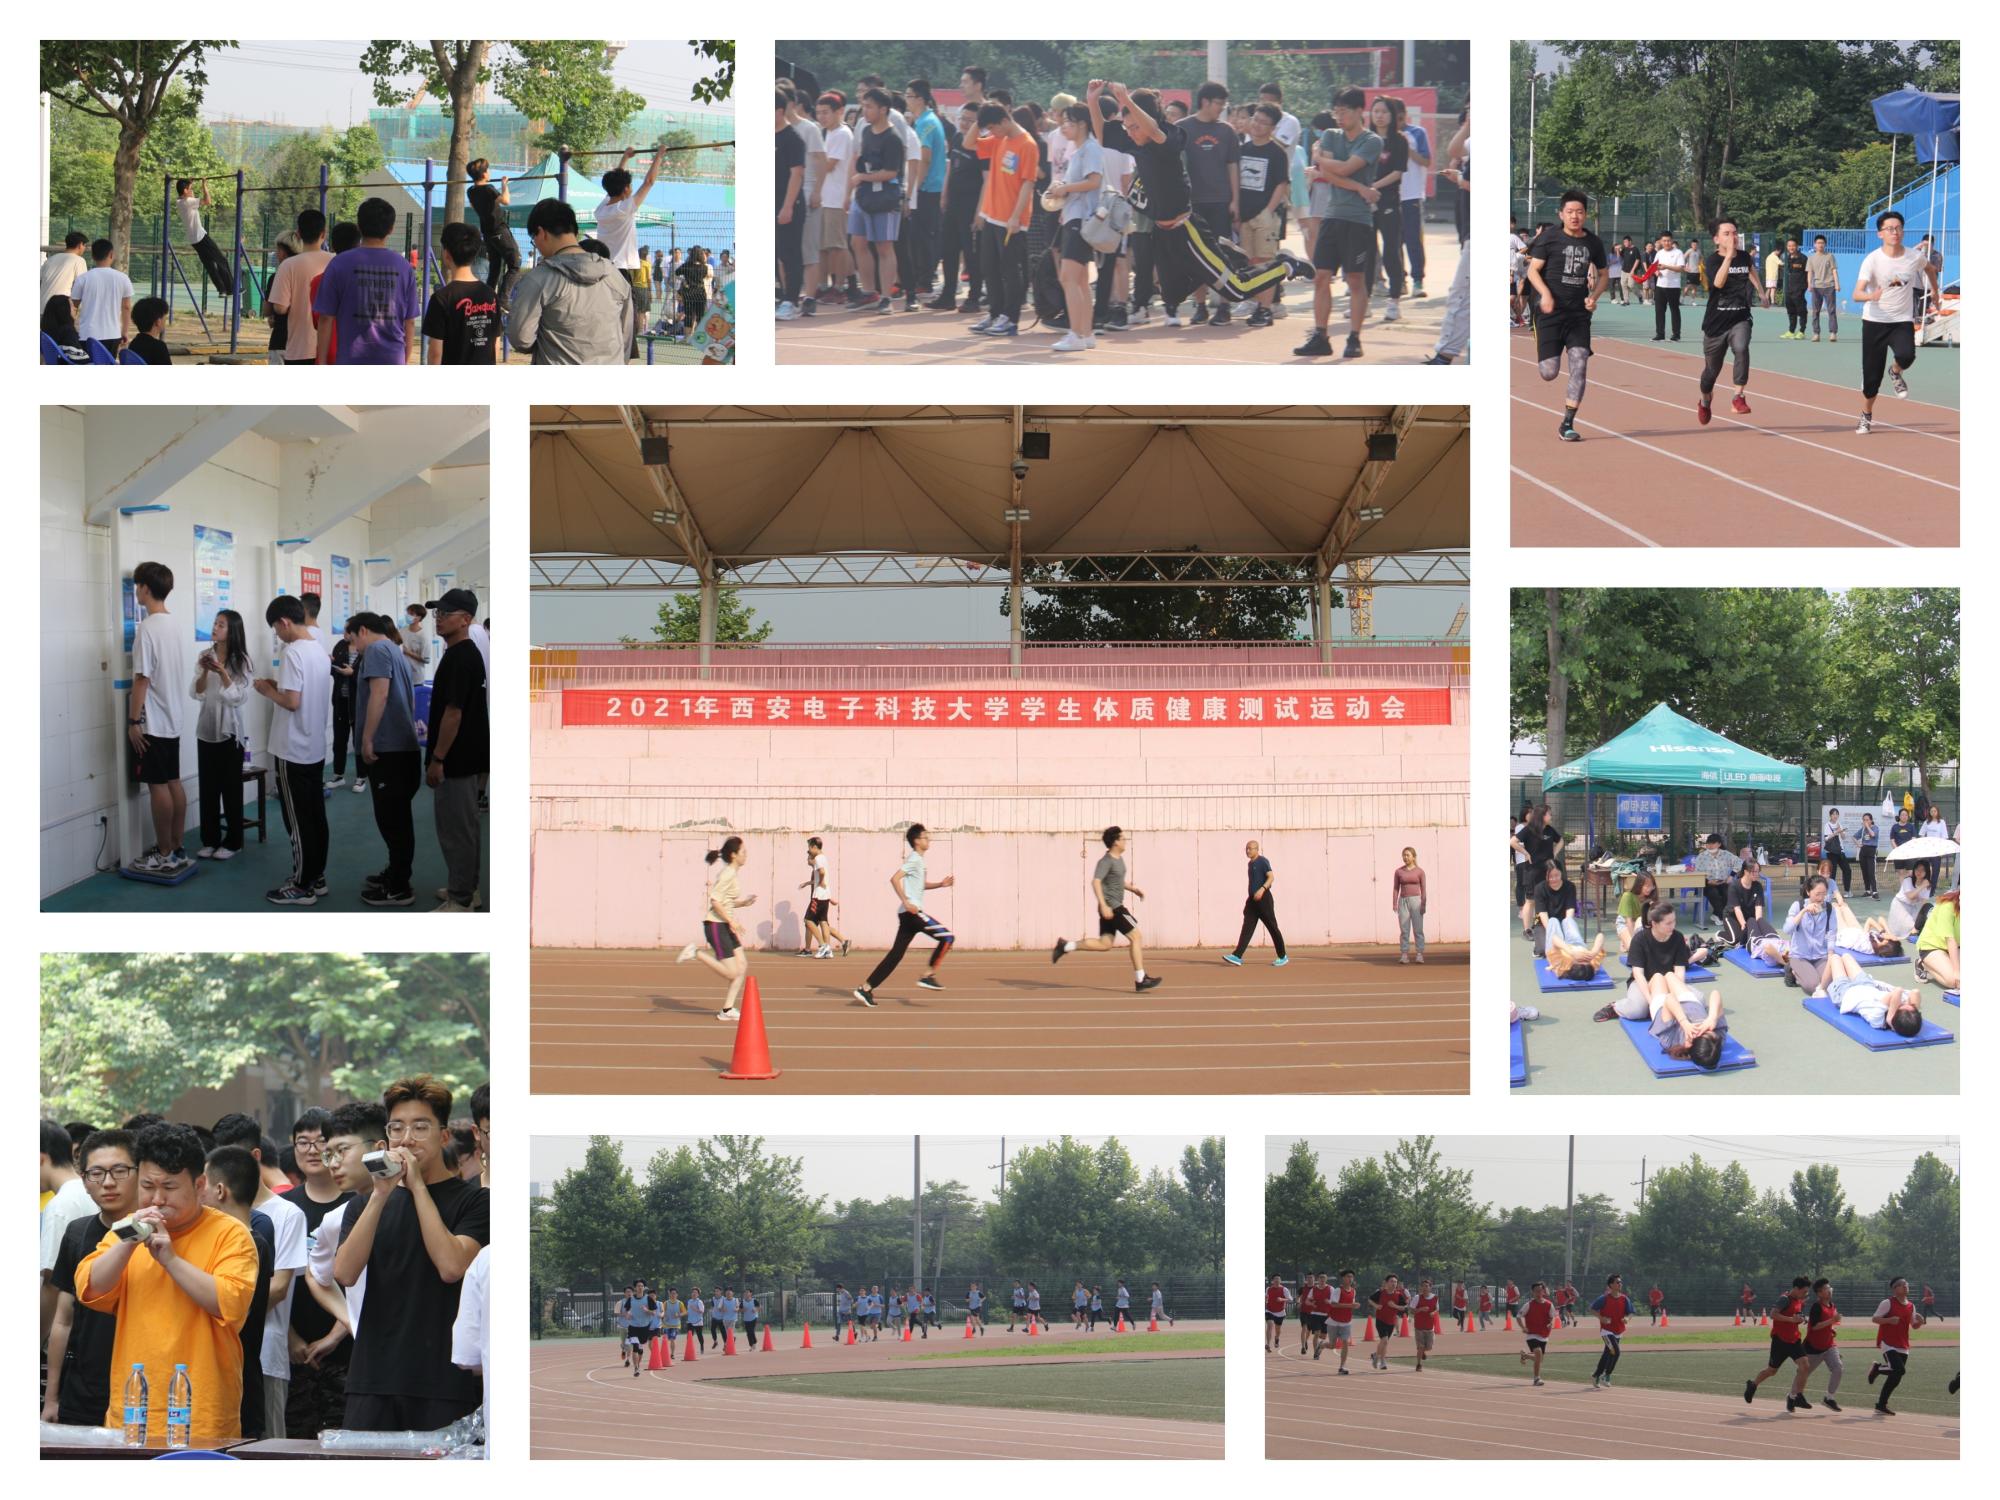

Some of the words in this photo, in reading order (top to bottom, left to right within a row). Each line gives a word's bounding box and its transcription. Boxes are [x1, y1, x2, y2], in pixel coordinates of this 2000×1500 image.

[606, 695, 1406, 721] 2021年西安电子科技大学学生体质健康测试运动会
[1649, 744, 1735, 755] Hisense
